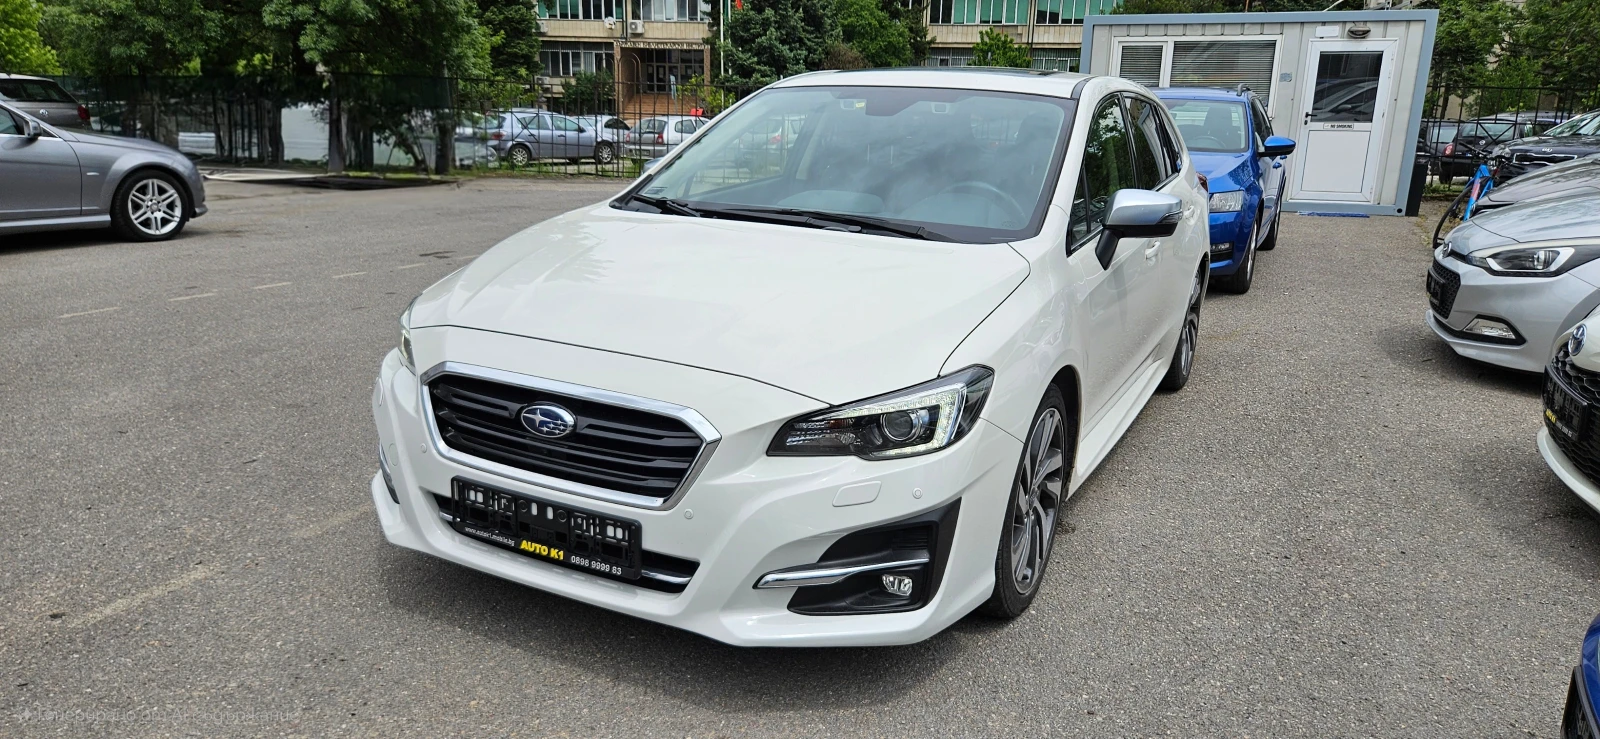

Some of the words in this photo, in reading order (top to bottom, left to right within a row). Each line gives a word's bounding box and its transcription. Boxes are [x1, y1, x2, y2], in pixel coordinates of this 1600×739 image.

[520, 539, 549, 556] AUTO
[550, 548, 564, 561] K1
[571, 555, 589, 567] 0898
[591, 560, 610, 572] 9999
[612, 566, 622, 575] 83
